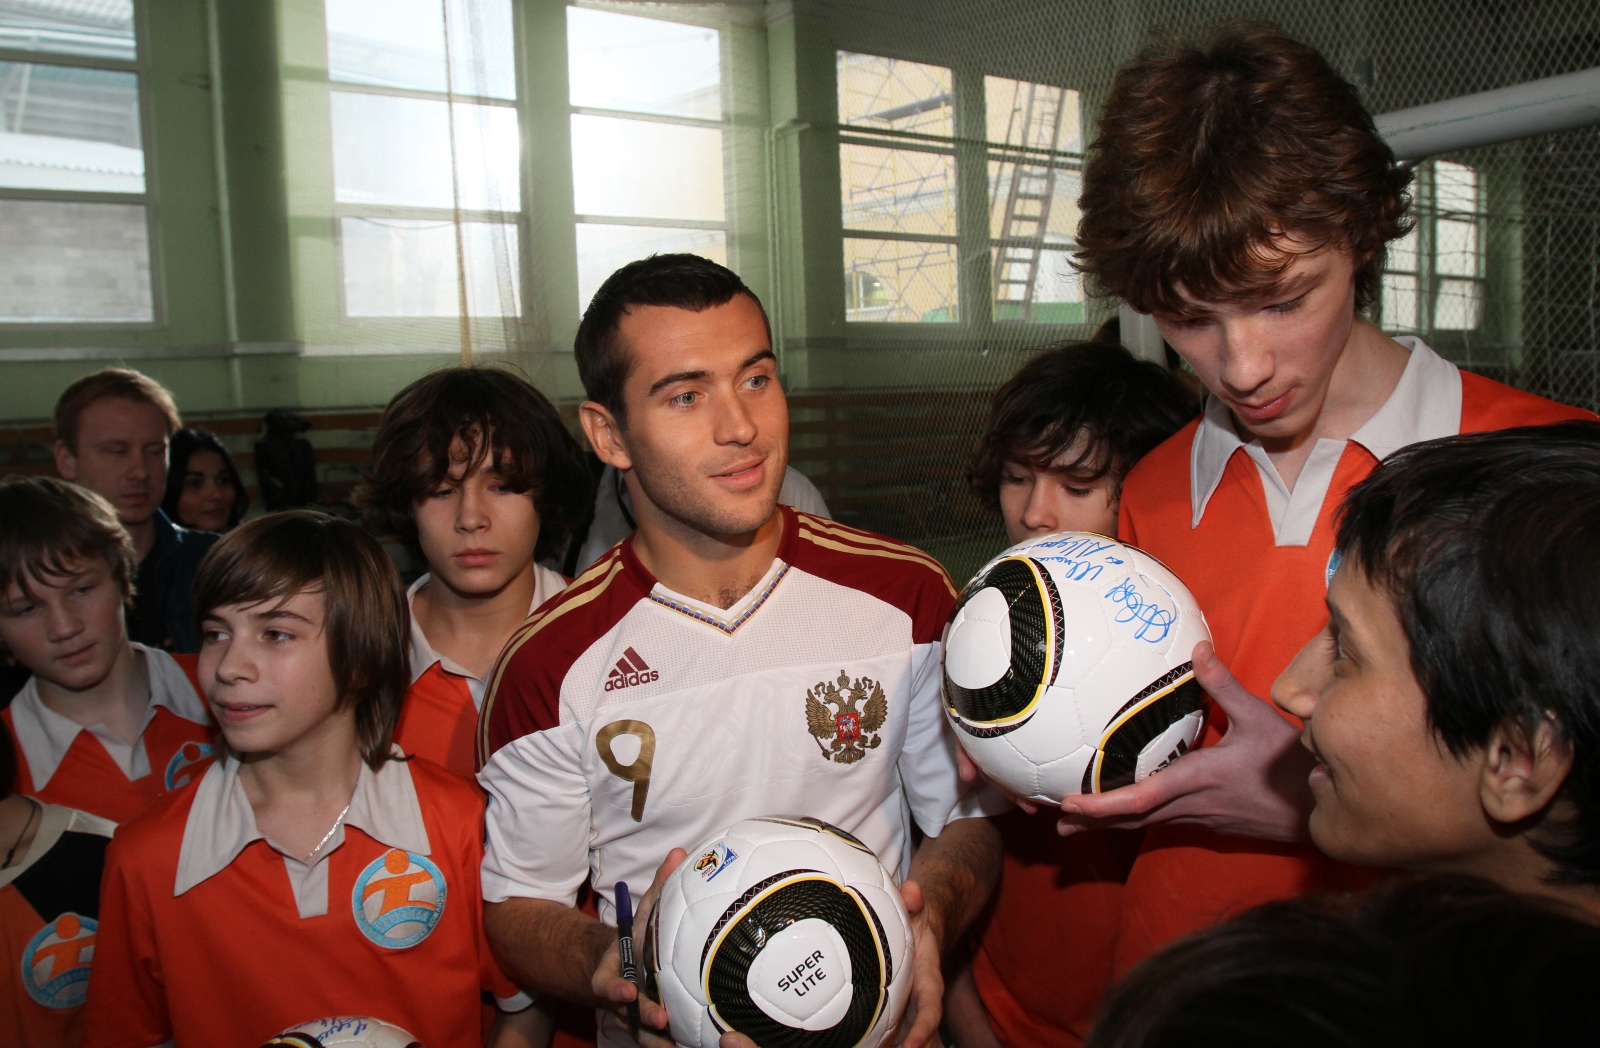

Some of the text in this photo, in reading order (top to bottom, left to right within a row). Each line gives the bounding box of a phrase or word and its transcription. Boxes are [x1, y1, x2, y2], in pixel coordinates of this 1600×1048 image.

[604, 668, 659, 692] adidas
[595, 719, 656, 823] 9
[777, 949, 826, 993] SUPER
[794, 967, 827, 997] LITE
